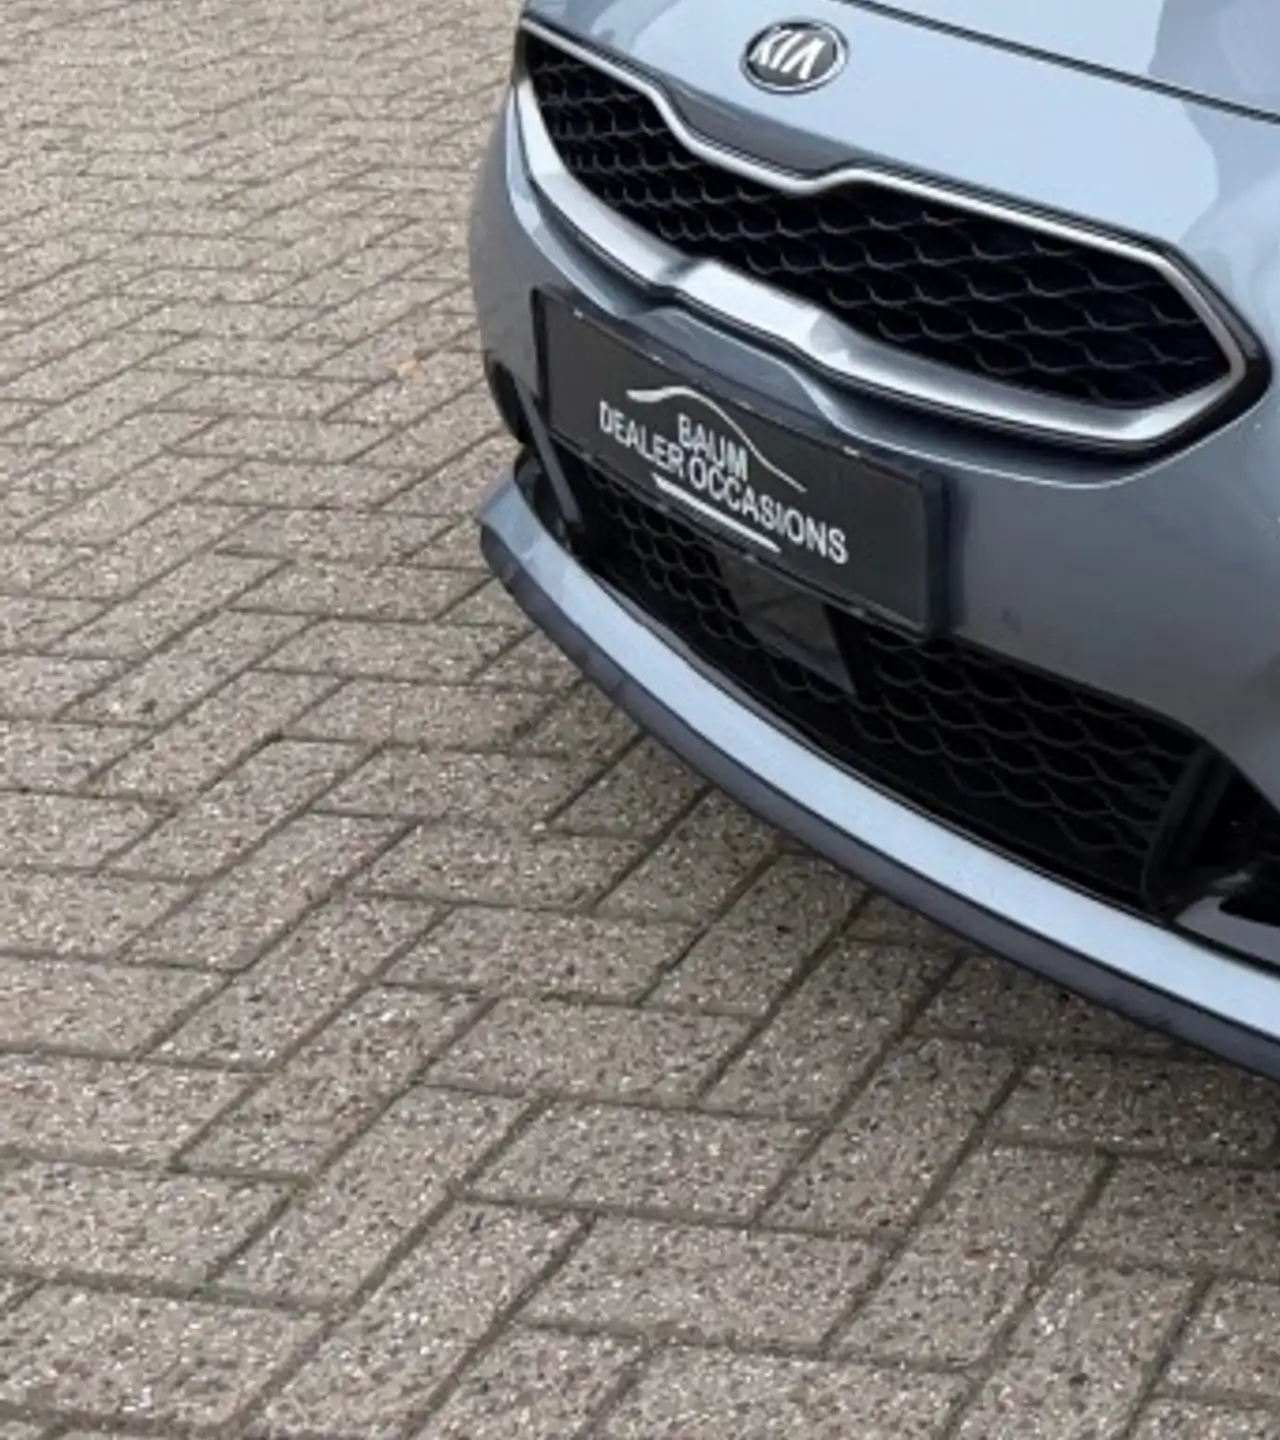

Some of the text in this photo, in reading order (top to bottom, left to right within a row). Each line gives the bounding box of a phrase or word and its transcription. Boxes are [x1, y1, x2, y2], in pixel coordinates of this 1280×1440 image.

[750, 29, 826, 80] KIA
[678, 413, 749, 482] BAUM
[599, 401, 849, 564] DEALER OCCASIONS
